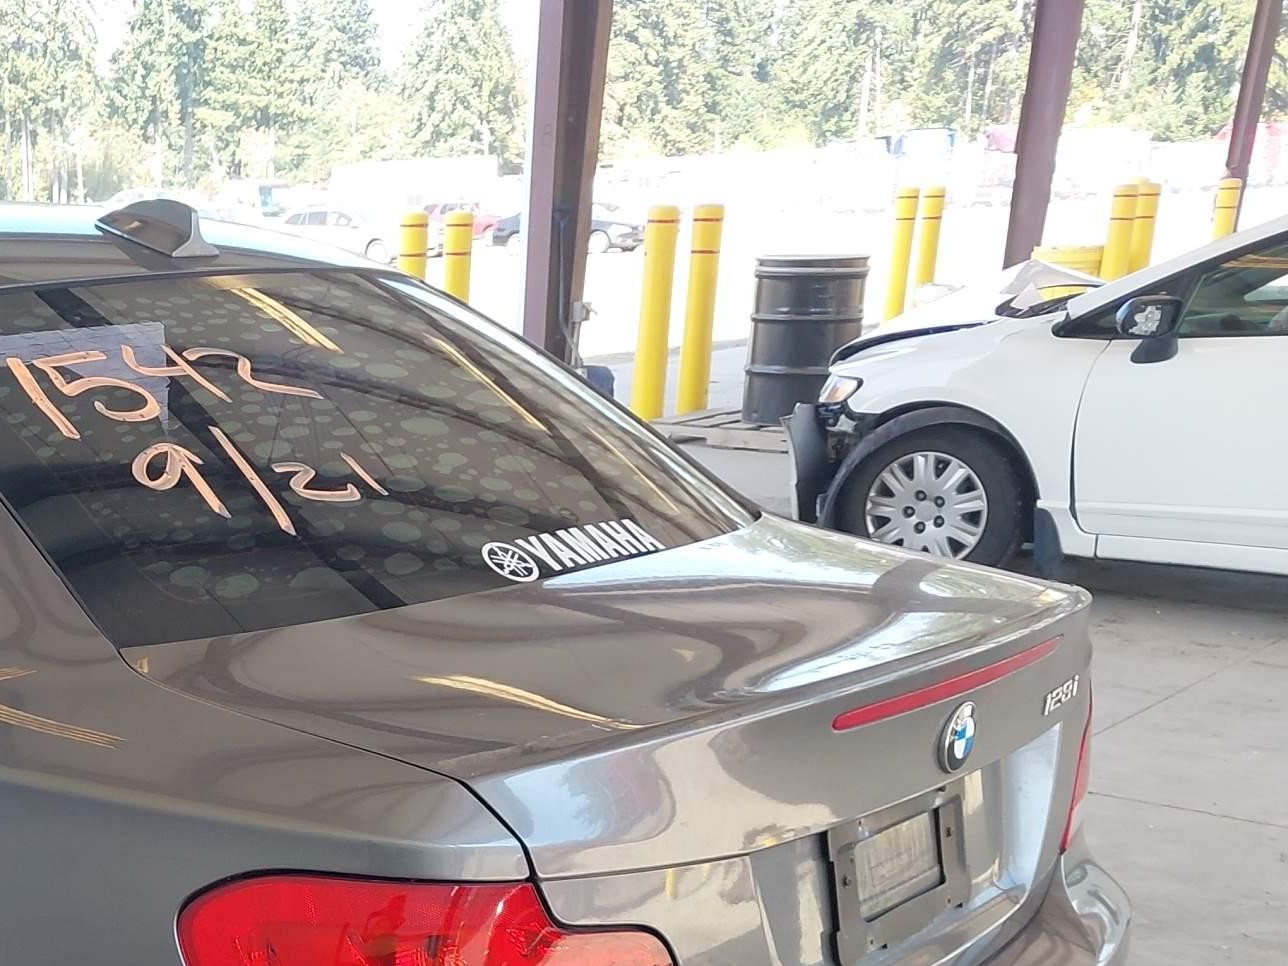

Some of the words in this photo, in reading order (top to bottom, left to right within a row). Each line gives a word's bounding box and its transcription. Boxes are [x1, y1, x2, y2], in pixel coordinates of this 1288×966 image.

[6, 344, 324, 440] 1542
[131, 425, 390, 537] 9/21
[514, 518, 666, 572] YAMAHA
[1044, 674, 1080, 716] 128i
